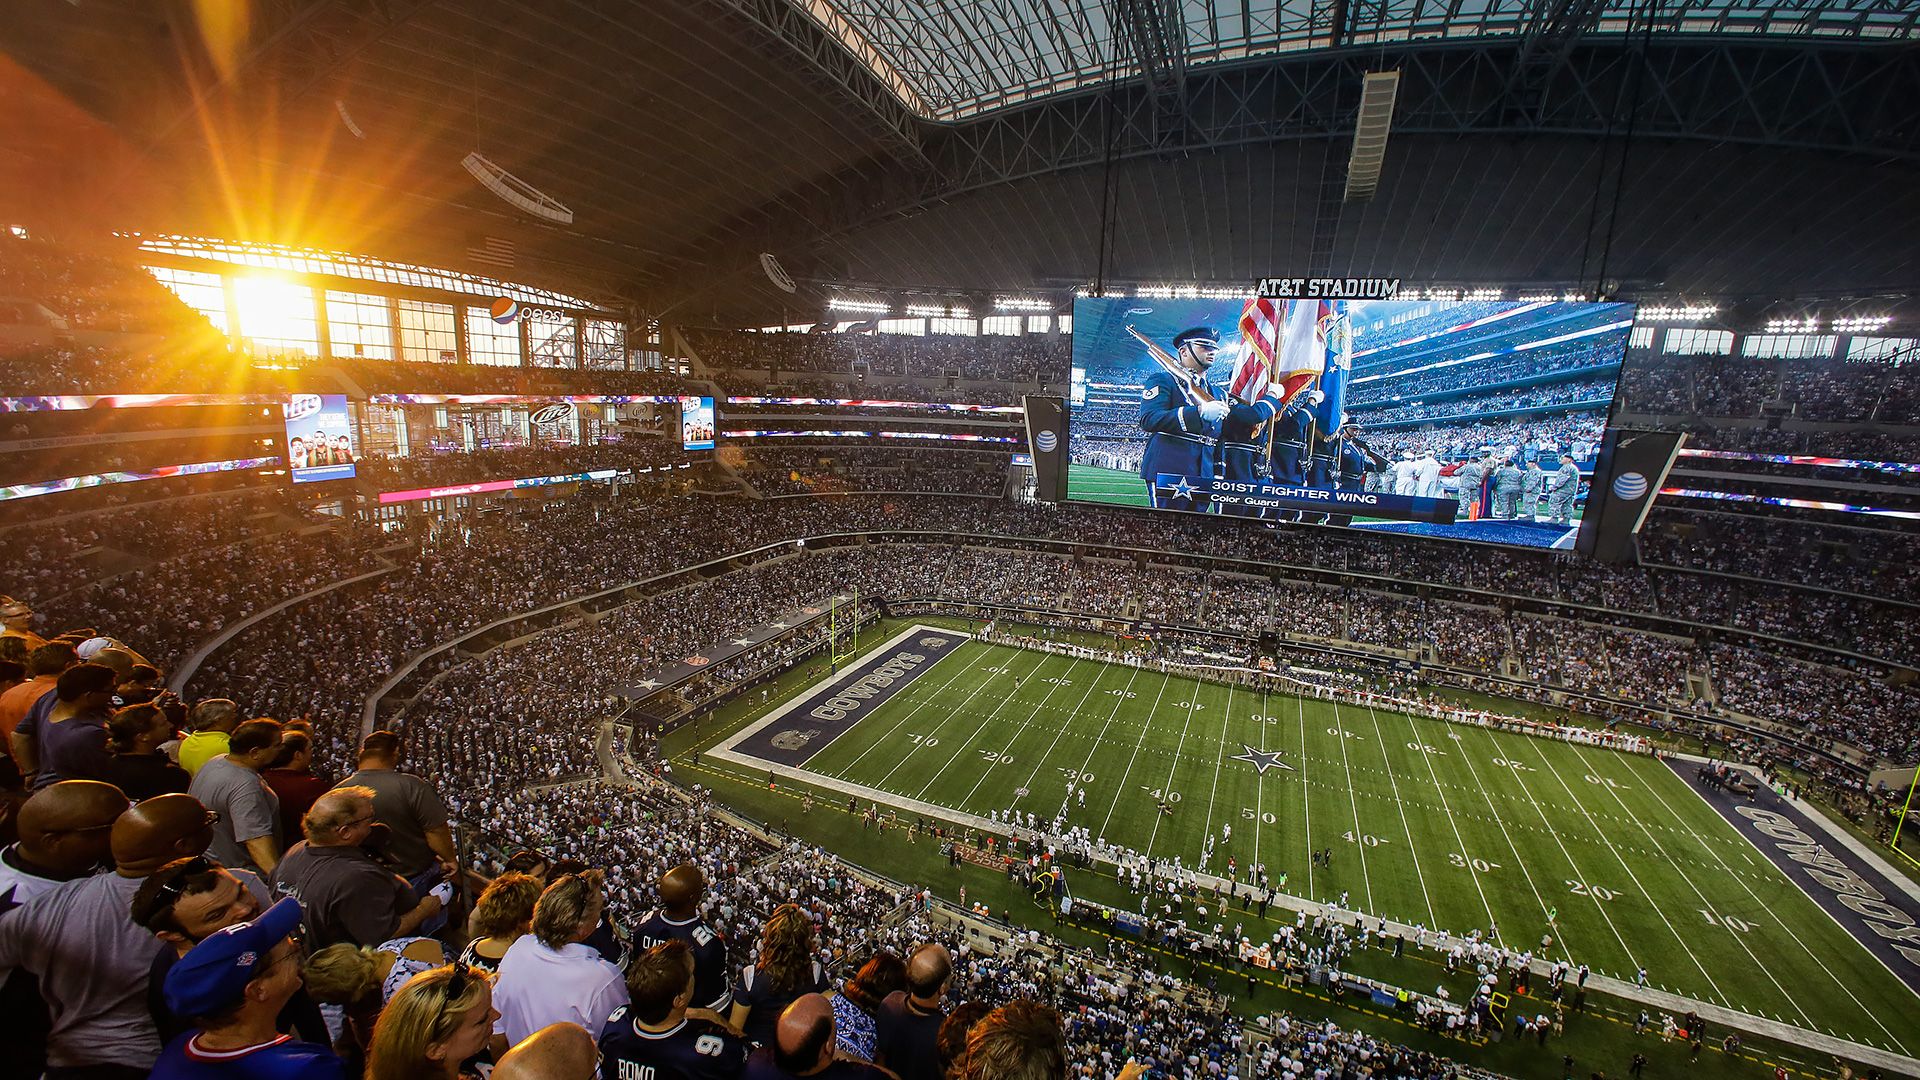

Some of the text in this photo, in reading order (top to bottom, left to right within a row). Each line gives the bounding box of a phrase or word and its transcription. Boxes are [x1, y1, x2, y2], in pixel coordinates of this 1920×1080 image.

[1257, 278, 1400, 297] AT&T STADIUM
[520, 307, 566, 325] pepsi
[537, 404, 571, 422] Lite
[1210, 494, 1280, 508] Color Guard
[1211, 481, 1377, 504] 301ST FIGHTER WING
[990, 666, 1011, 675] 10
[810, 651, 926, 721] COWBOYS
[1251, 714, 1278, 725] 50
[914, 735, 939, 748] 10
[1326, 726, 1356, 740] 40
[1406, 741, 1439, 756] 30
[982, 750, 1014, 765] 20
[1492, 756, 1528, 772] 20
[1065, 768, 1095, 784] 30
[1584, 774, 1623, 789] 10
[1149, 787, 1182, 803] 40
[1241, 807, 1277, 825] 50
[1341, 830, 1379, 848] 40
[959, 846, 1005, 862] OOTBALL
[1448, 853, 1492, 873] 30
[1564, 879, 1614, 901] 20
[1696, 908, 1749, 933] 10
[695, 1034, 724, 1057] 9
[618, 1059, 655, 1080] ROMO
